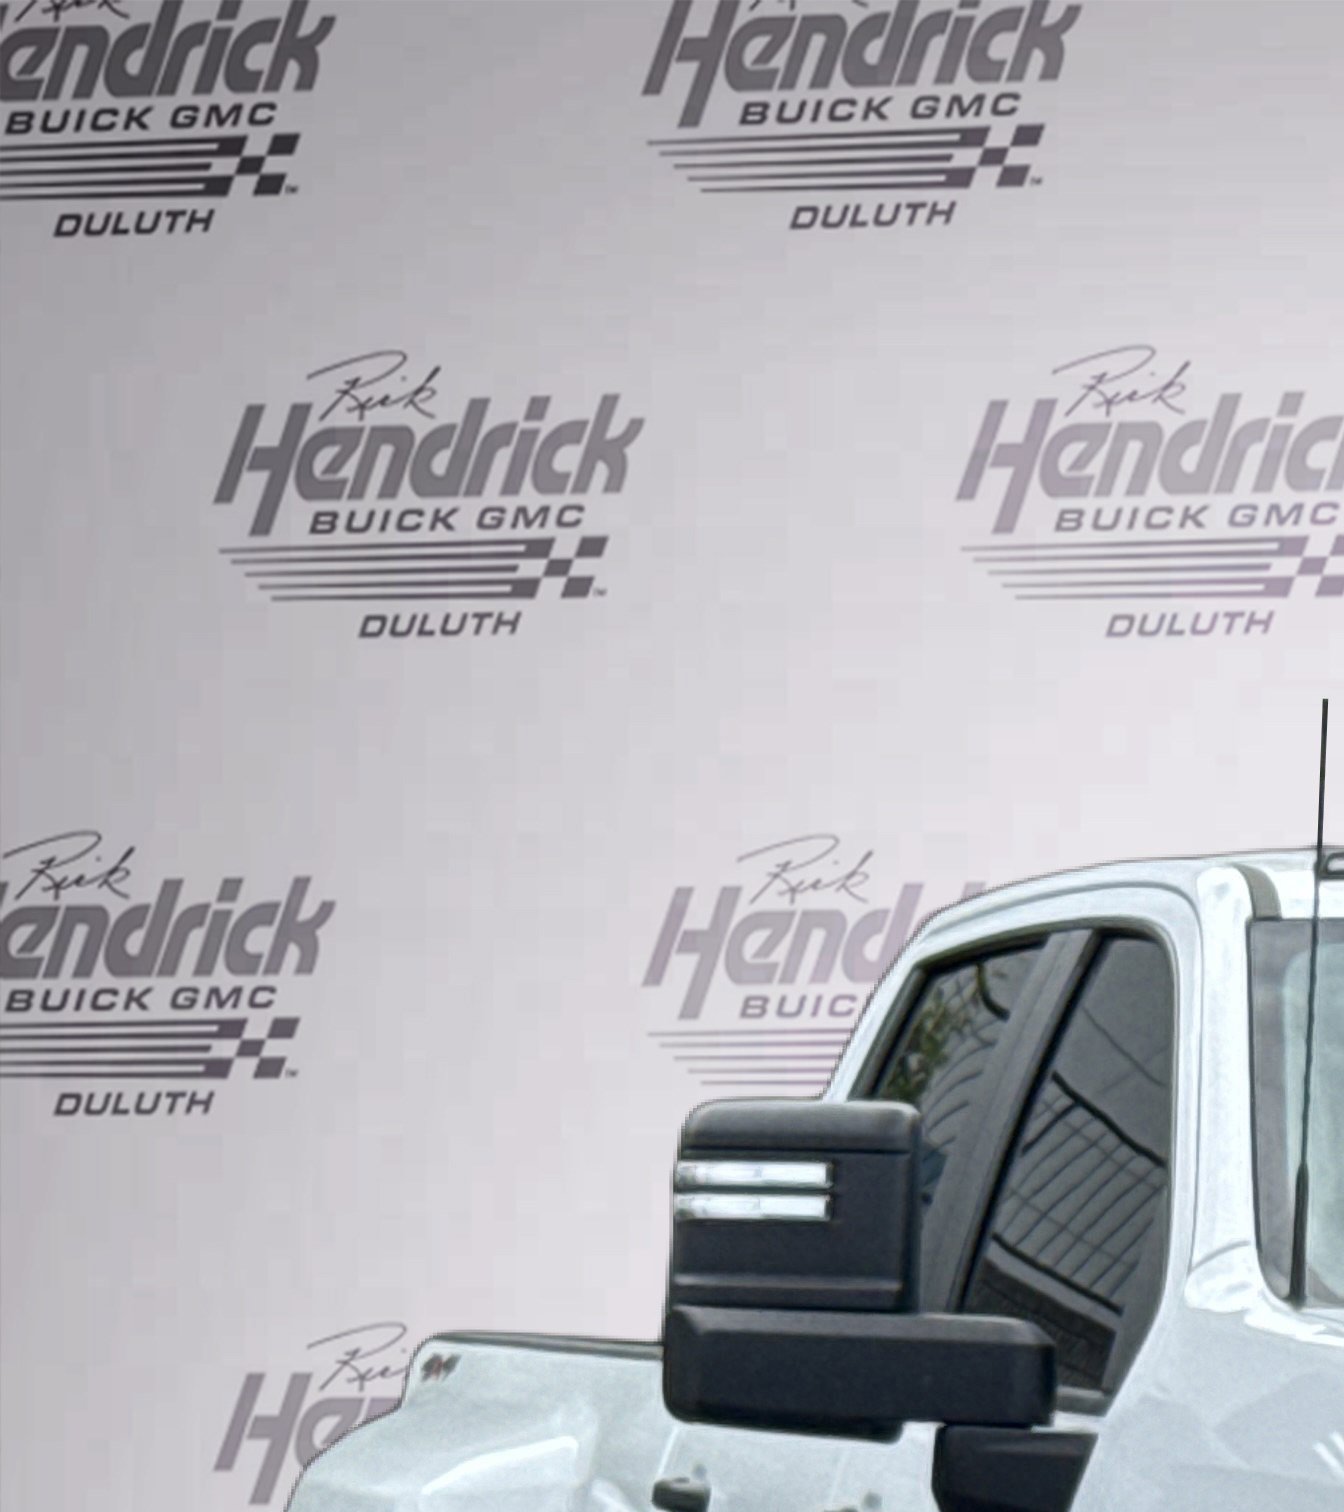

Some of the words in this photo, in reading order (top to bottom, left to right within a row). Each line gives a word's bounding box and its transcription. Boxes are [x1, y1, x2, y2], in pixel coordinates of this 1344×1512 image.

[0, 0, 336, 101] endrick
[641, 0, 1083, 128] Hendrick
[4, 105, 154, 135] BUICK
[169, 102, 278, 129] GMC
[738, 96, 894, 126] BUICK
[909, 92, 1022, 120] GMC
[53, 208, 215, 237] DULUTH
[788, 201, 957, 230] DULUTH
[307, 350, 441, 422] Rick
[1052, 344, 1191, 417] Rick
[214, 394, 645, 537] Hendrick
[308, 506, 460, 535] BUICK
[476, 504, 586, 530] GMC
[1054, 504, 1209, 533] BUICK
[1228, 501, 1341, 529] GMC
[358, 611, 523, 639] DULUTH
[1105, 610, 1276, 639] DULUTH
[2, 829, 136, 901] Rick
[736, 832, 875, 906] Rick
[0, 876, 337, 980] endrick
[641, 881, 942, 1020] Hend
[4, 987, 154, 1013] BUICK
[169, 986, 278, 1010] GMC
[739, 995, 862, 1019] BUIC
[53, 1090, 215, 1117] DULUTH
[306, 1321, 409, 1393] Ric
